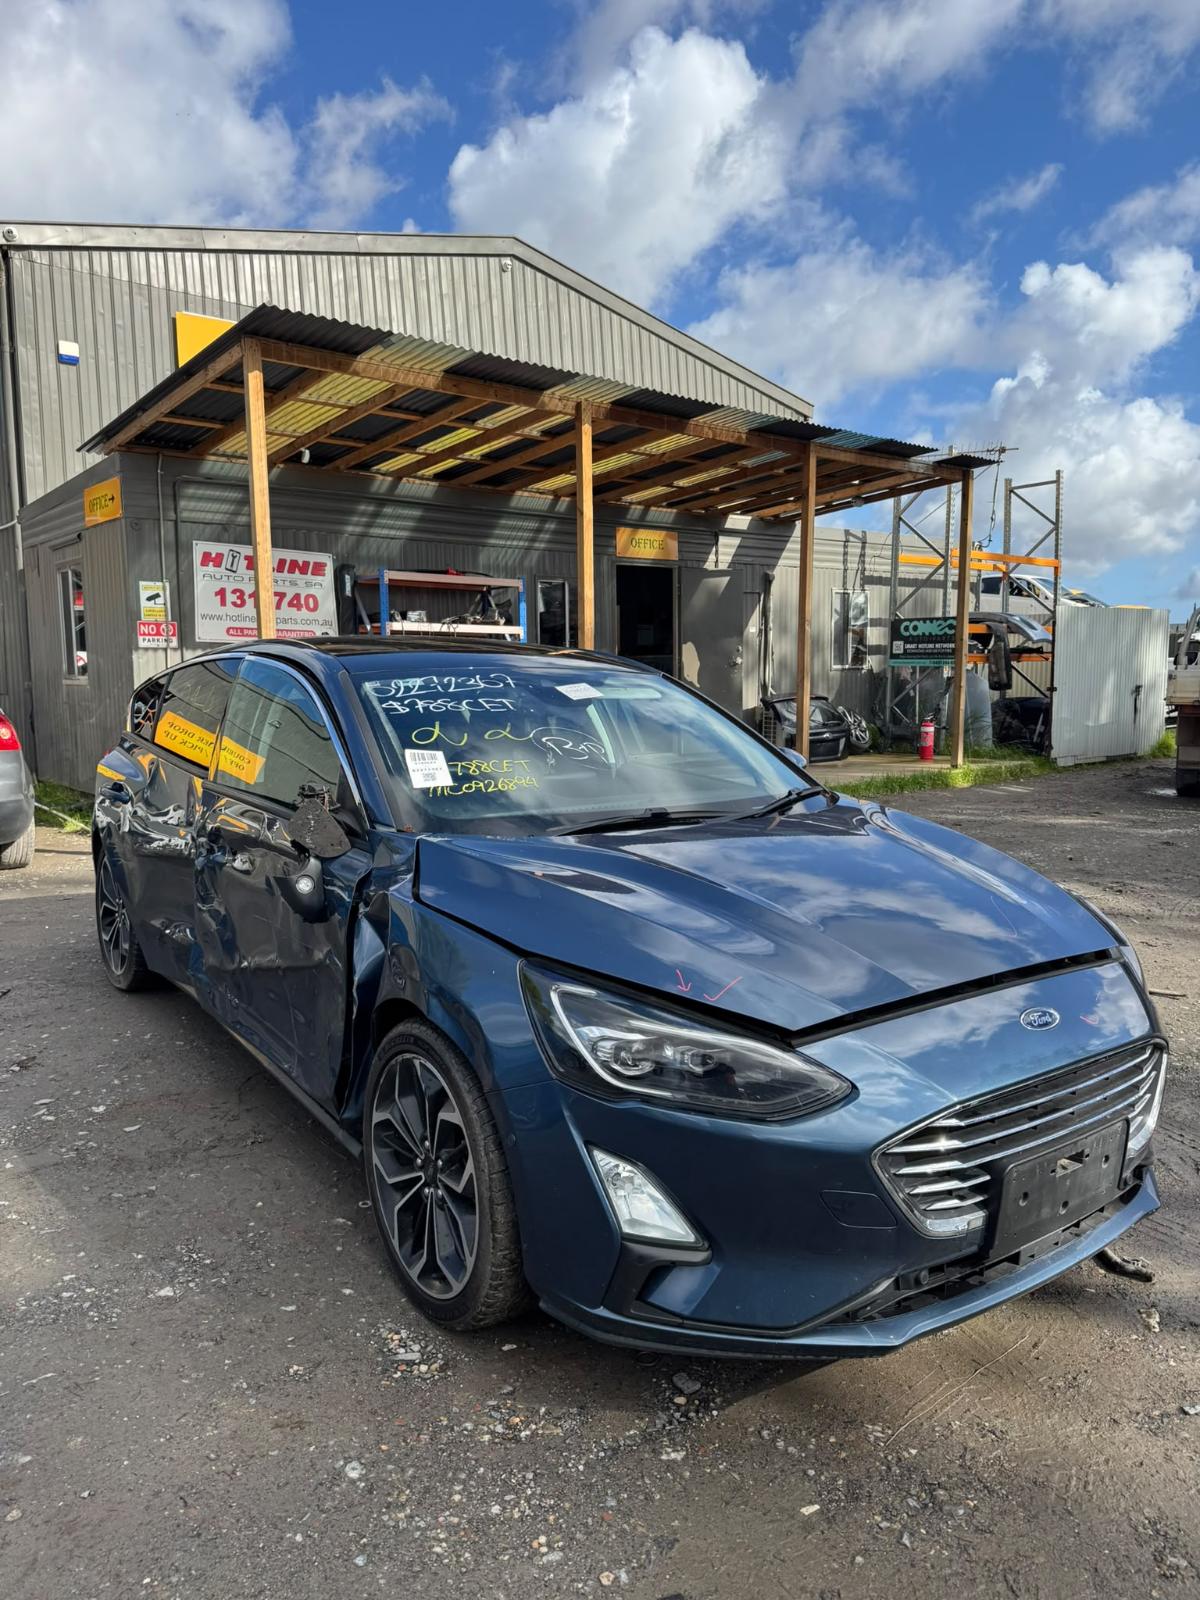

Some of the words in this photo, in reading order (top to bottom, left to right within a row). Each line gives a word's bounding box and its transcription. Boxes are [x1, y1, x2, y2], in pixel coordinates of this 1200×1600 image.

[630, 537, 665, 550] OFFICE
[202, 573, 244, 582] AUTO
[304, 581, 323, 589] SA
[273, 591, 319, 613] 740
[140, 624, 156, 635] NO
